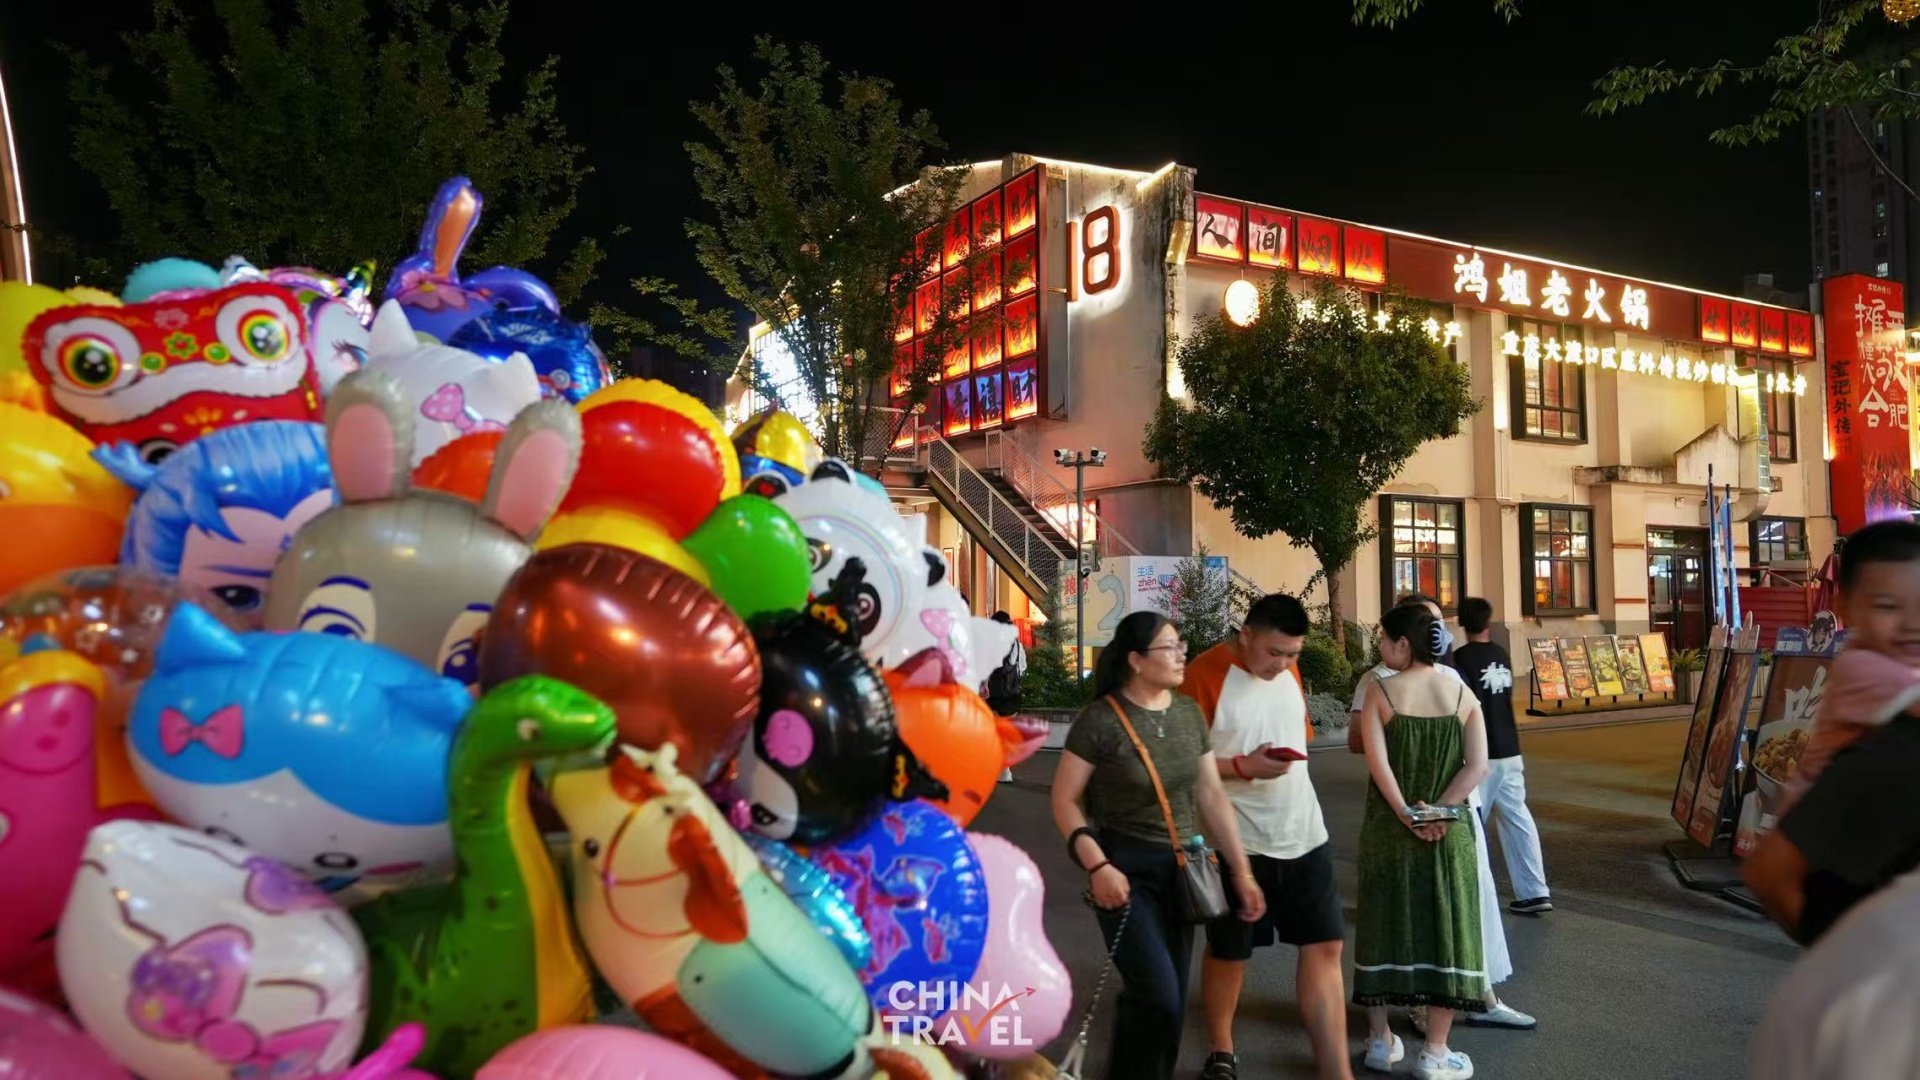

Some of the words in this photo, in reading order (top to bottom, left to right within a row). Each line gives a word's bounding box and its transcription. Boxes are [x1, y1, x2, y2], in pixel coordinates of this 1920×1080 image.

[1066, 205, 1121, 303] 18
[1453, 252, 1650, 331] 鸿姐老火锅
[1830, 360, 1851, 434] 宝记外传
[1858, 386, 1909, 431] 合肥
